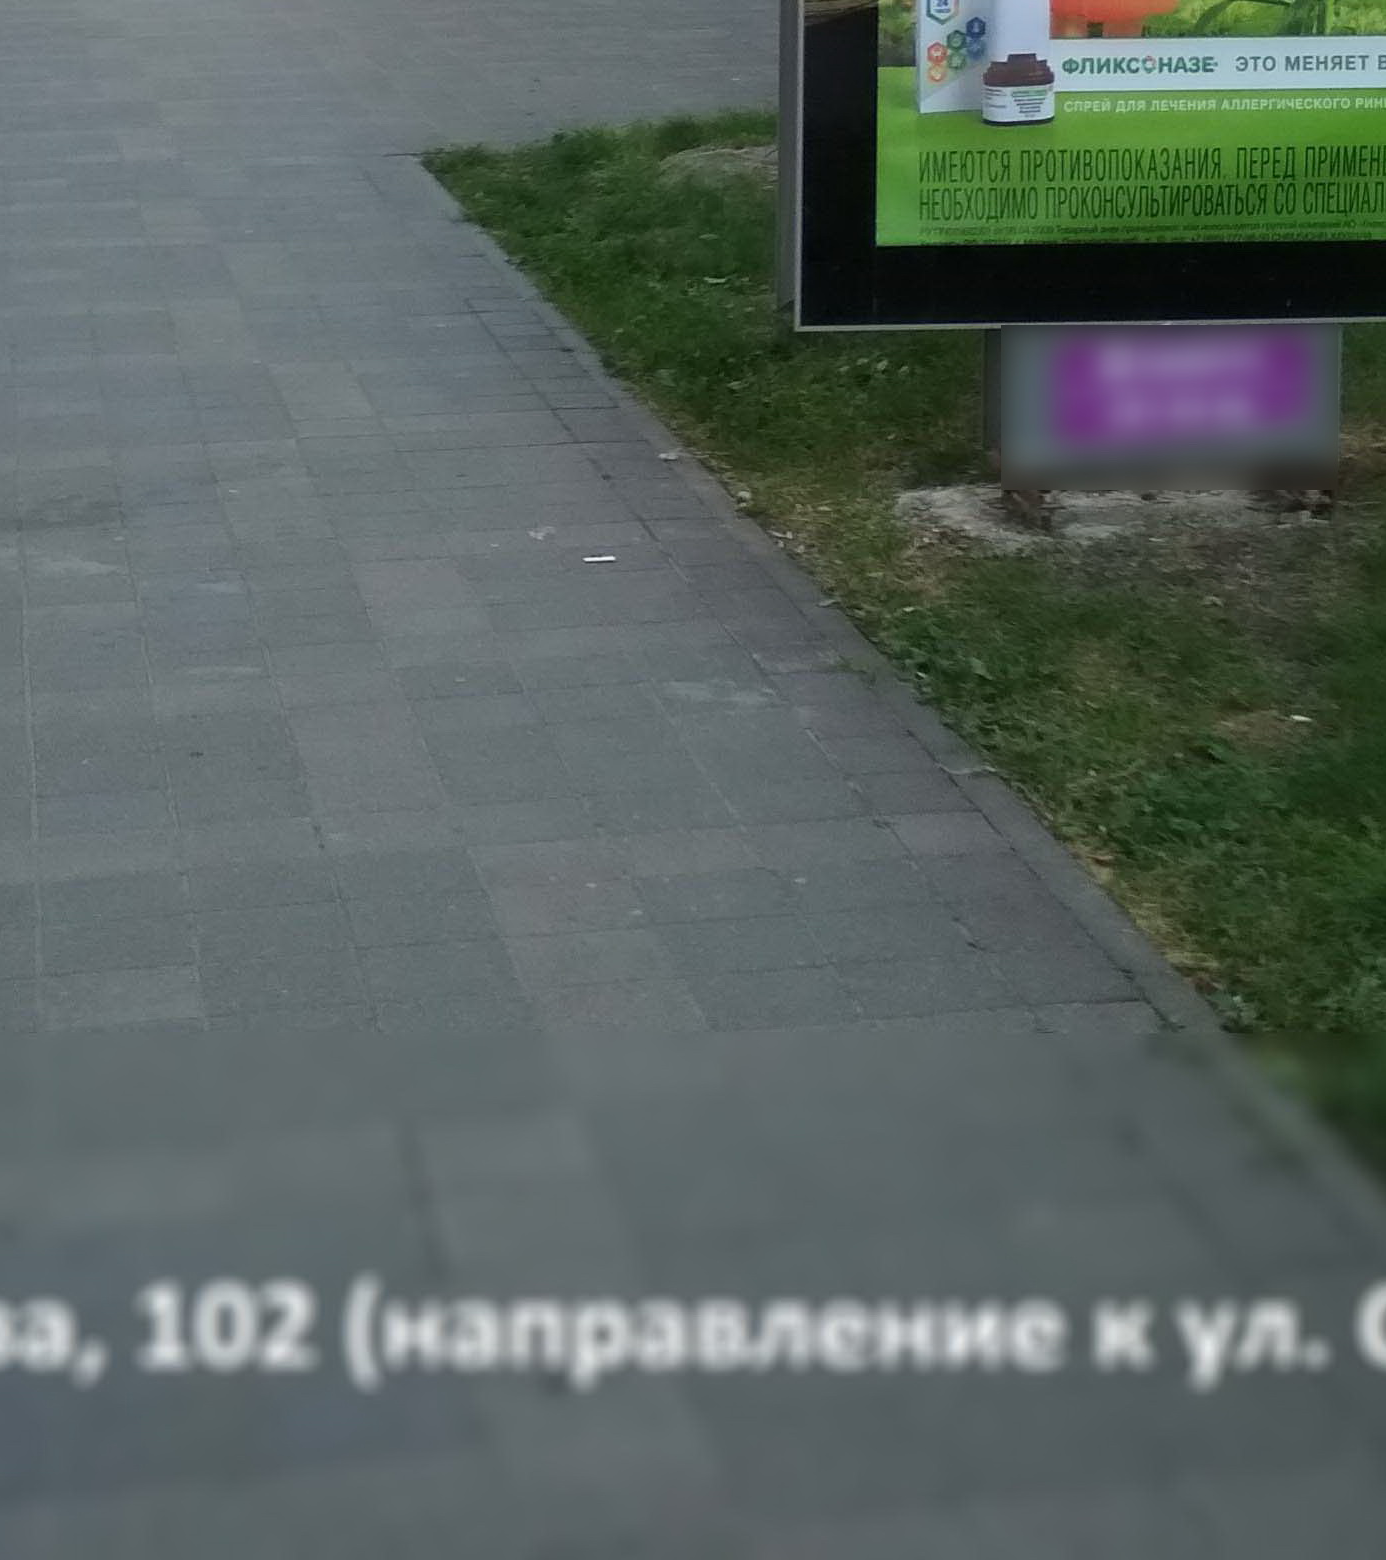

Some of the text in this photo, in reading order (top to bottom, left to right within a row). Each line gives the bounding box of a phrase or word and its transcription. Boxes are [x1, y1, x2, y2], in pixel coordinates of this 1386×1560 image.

[1235, 56, 1277, 72] ЭТО
[1284, 54, 1369, 72] МЕНЯЕТ
[1063, 97, 1111, 113] СПРЕЙ
[1115, 98, 1146, 113] ДЛЯ
[1150, 98, 1216, 112] ЛЕЧЕНИЯ
[1220, 96, 1351, 111] АЛЛЕРГИЧЕСКОГО
[919, 150, 1011, 184] ИМЕЮТСЯ
[1020, 147, 1225, 183] ПРОТИВОПОКАЗАНИЯ.
[1236, 146, 1295, 181] ПЕРЕД
[919, 187, 1039, 223] НЕОБХОДИМО
[1045, 183, 1267, 220] ПРОКОНСУЛЬТИРОВАТЬСЯ
[1273, 182, 1296, 216] СО
